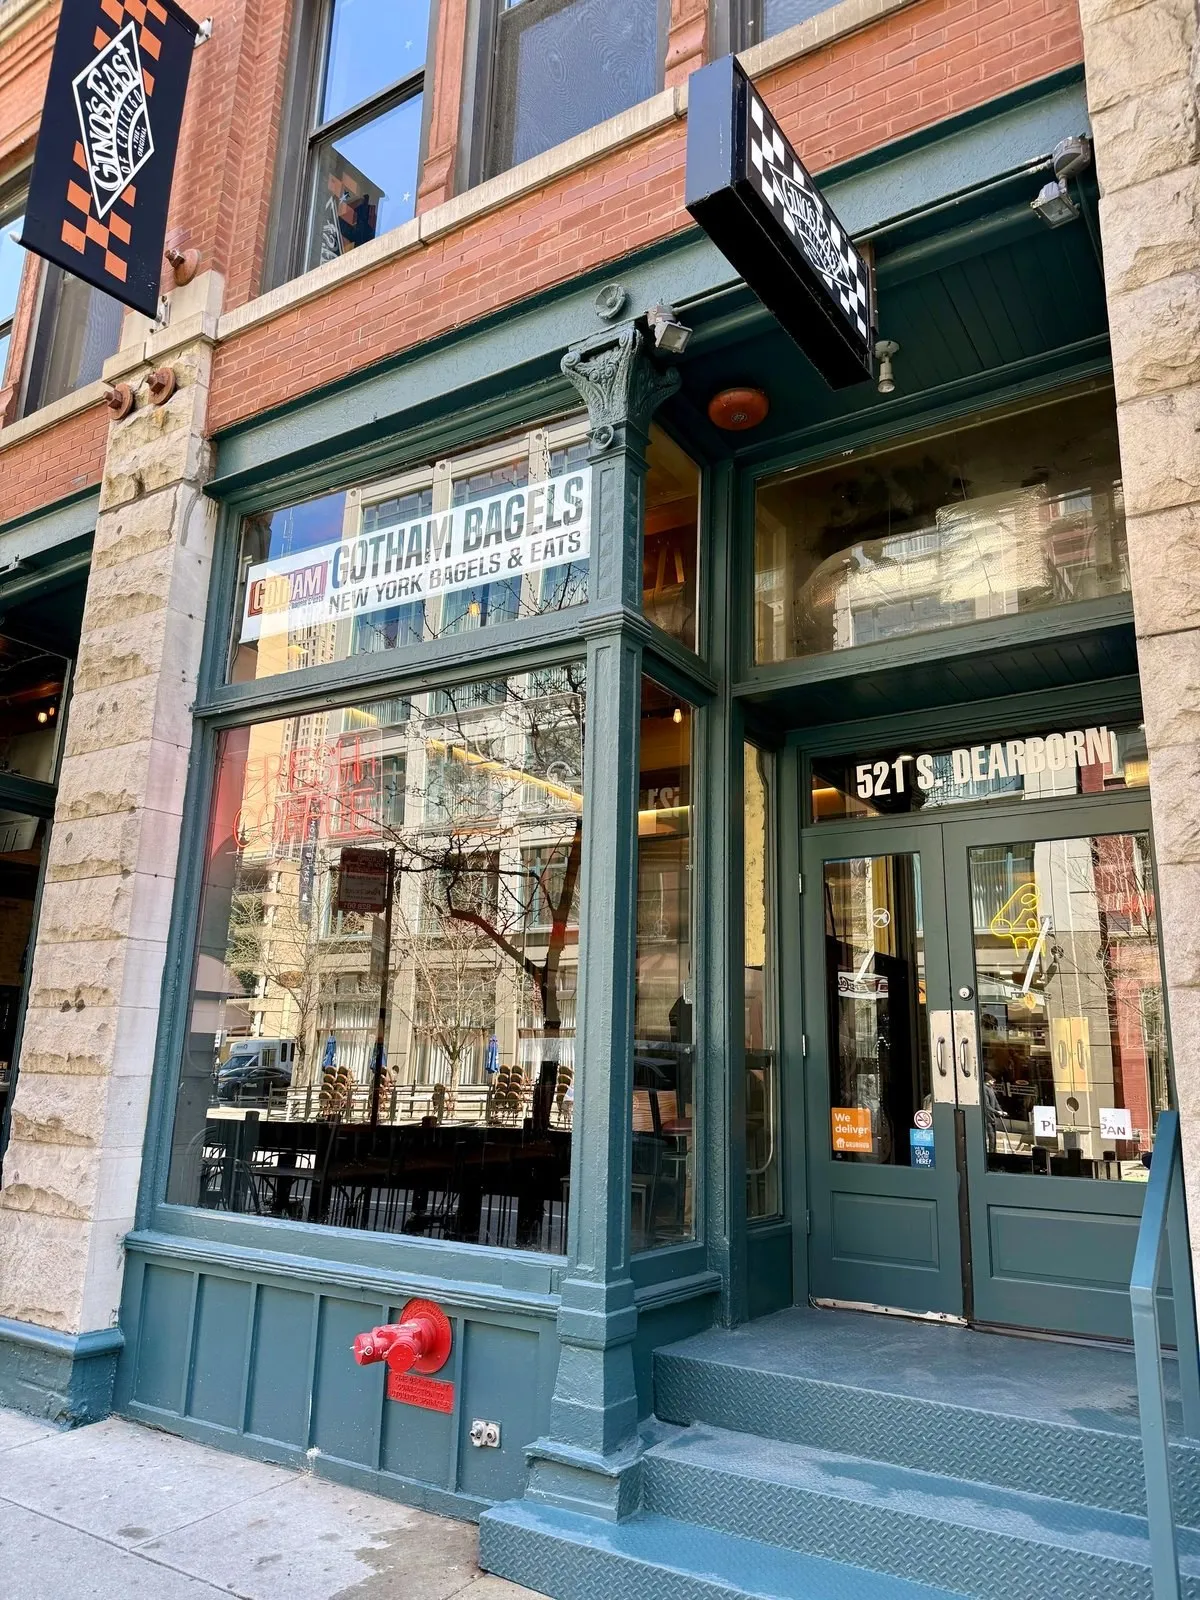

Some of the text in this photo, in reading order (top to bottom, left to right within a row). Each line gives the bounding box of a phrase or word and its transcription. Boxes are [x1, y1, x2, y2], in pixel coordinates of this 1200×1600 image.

[86, 42, 140, 191] GINO'S EAST
[116, 89, 143, 174] OF CHICAGO
[137, 126, 147, 157] ORIGINAL
[331, 476, 584, 589] GOTHAM BAGELS
[329, 530, 581, 615] NEW YORK BAGELS & EATS
[244, 735, 363, 799] FRESH
[856, 726, 1111, 799] 521 S. DEARBORN
[834, 1113, 851, 1122] We
[835, 1124, 868, 1134] deliver
